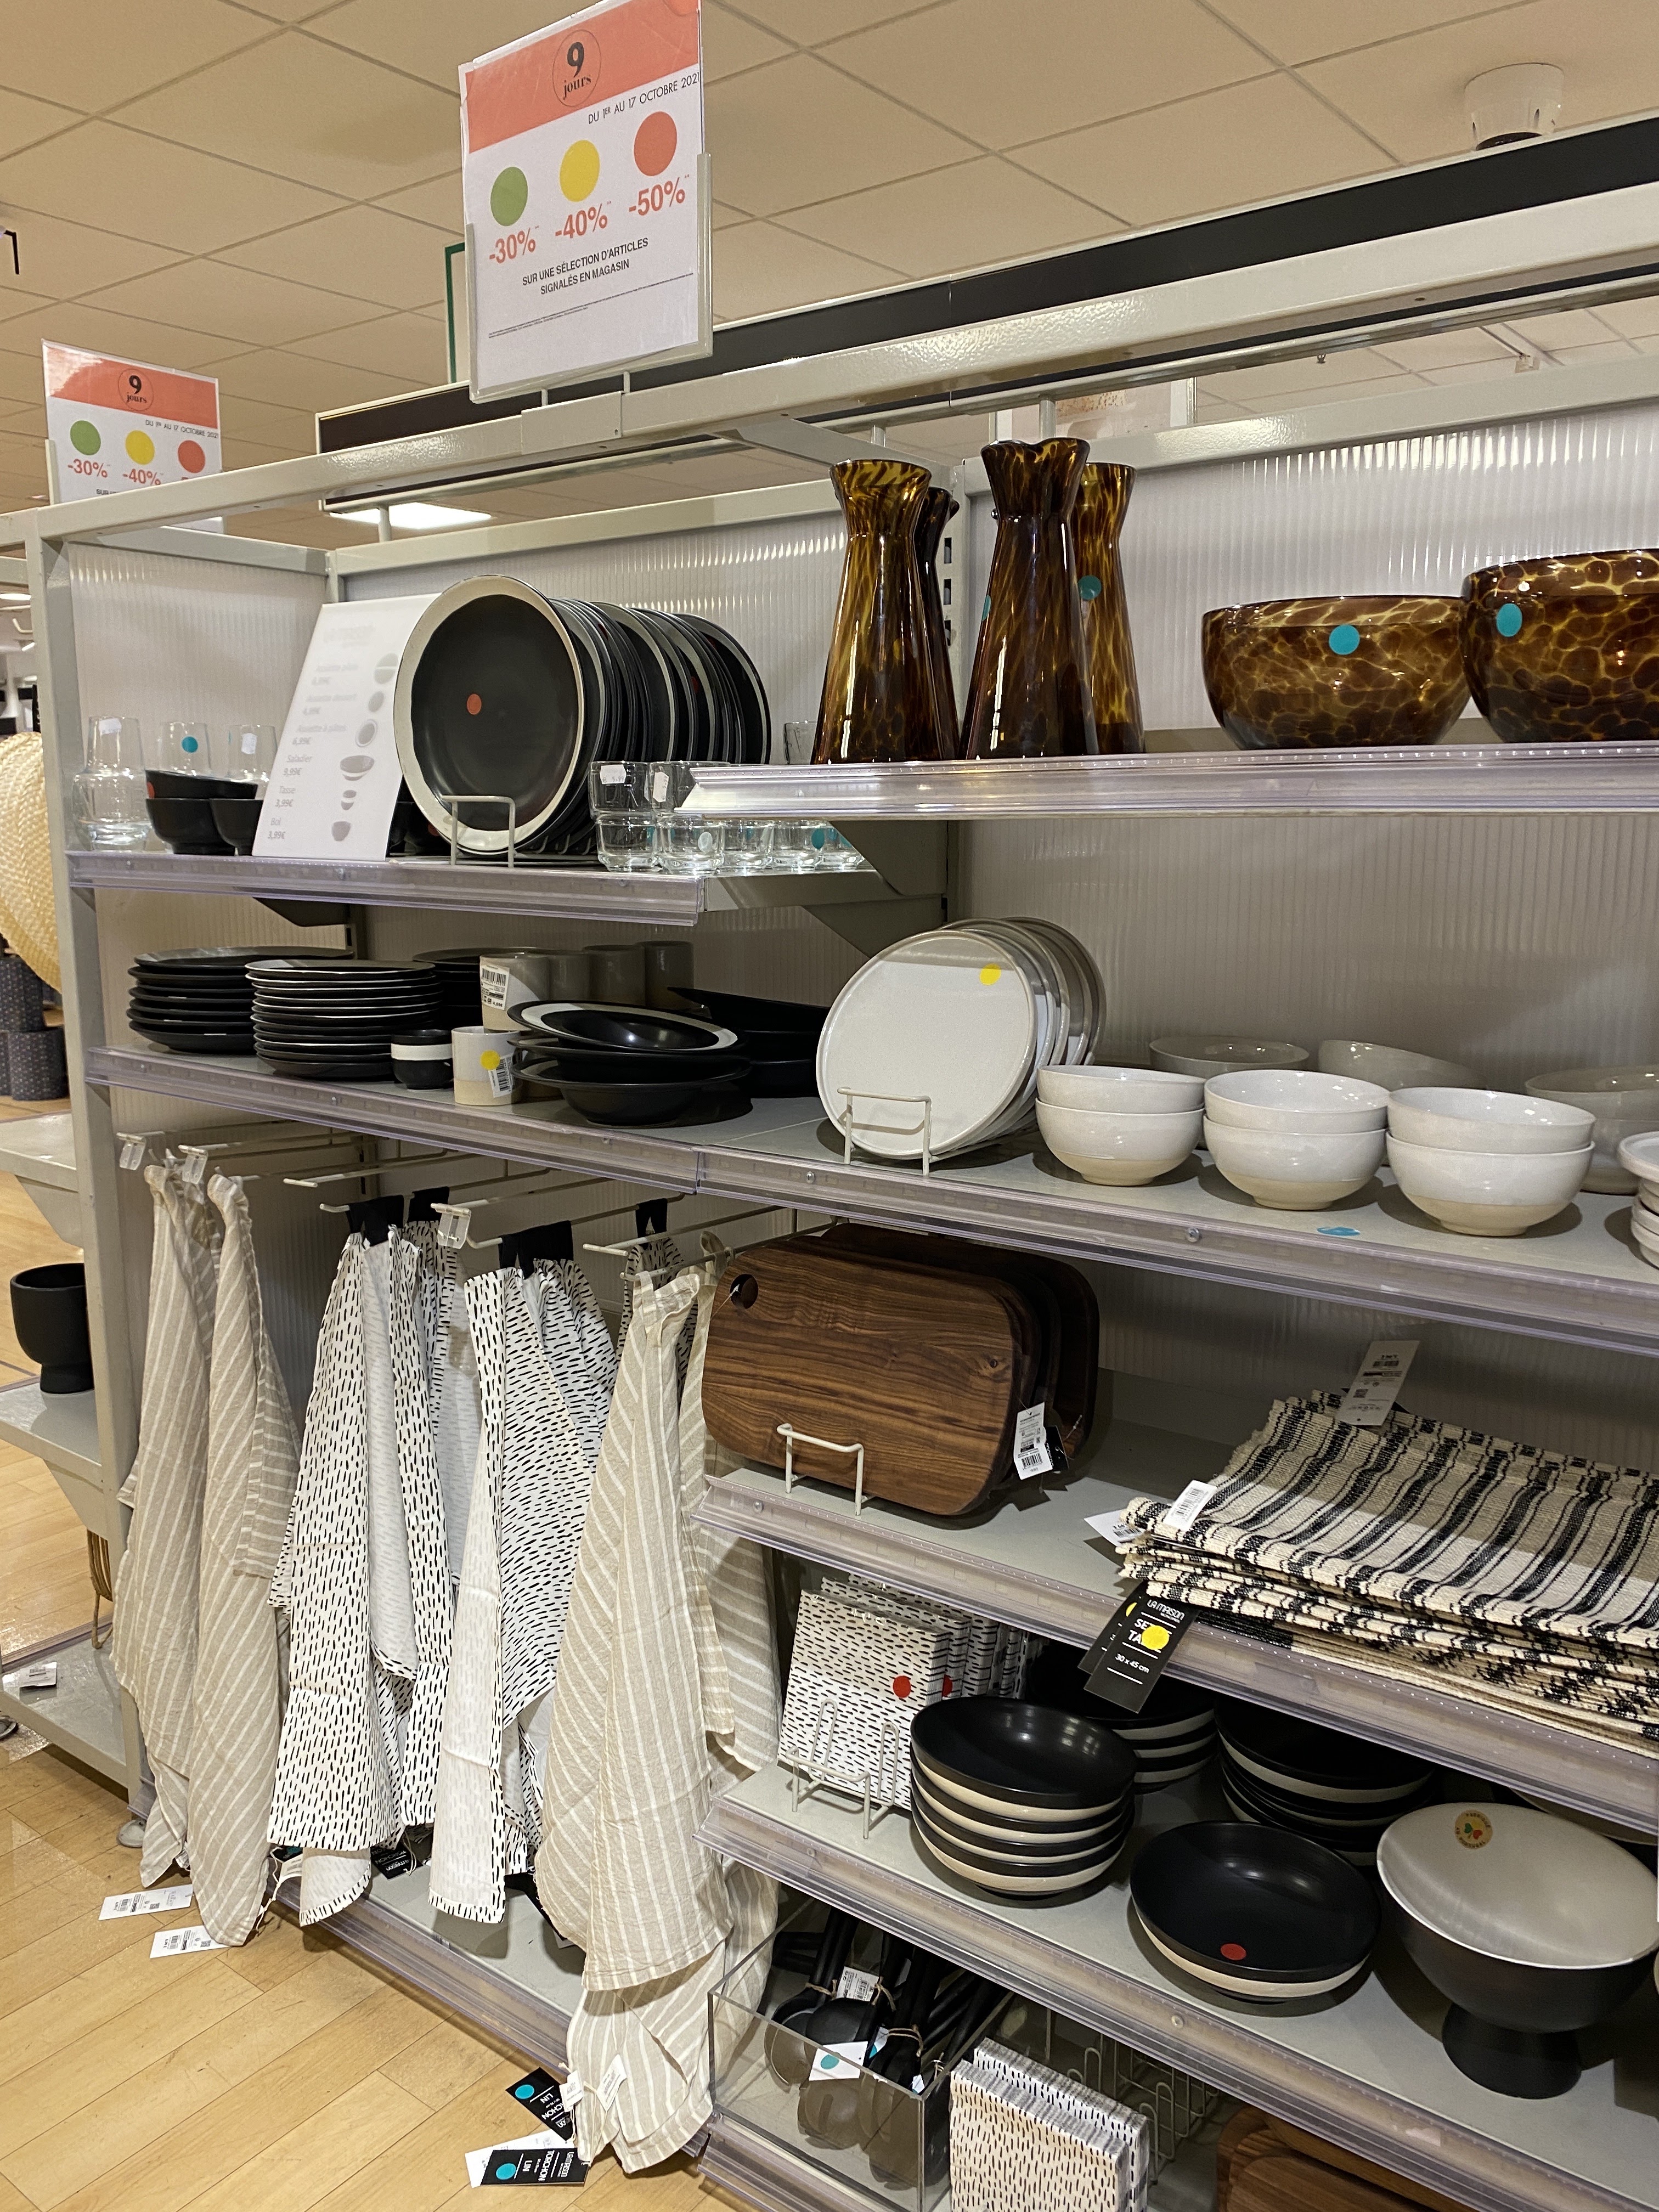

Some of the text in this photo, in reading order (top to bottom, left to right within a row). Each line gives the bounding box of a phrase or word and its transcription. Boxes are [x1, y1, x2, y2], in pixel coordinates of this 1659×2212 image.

[567, 41, 585, 78] 9
[562, 74, 591, 99] jours
[588, 111, 599, 124] DU
[614, 100, 625, 114] AU
[629, 96, 636, 109] 17
[639, 80, 678, 104] OCTOBRE
[681, 71, 699, 88] 2021
[522, 237, 649, 286] SUR UNE SÉLECTION D'ARTICLES
[540, 258, 630, 295] SIGNALÉS EN MAGASIN
[128, 375, 142, 394] 9
[126, 392, 147, 404] jours
[180, 426, 206, 436] OCTOBRE
[283, 768, 302, 777] 9,99€
[279, 786, 295, 794] Tasse
[275, 799, 293, 808] 3,99€
[270, 817, 281, 826] Bol
[268, 831, 285, 840] 3,99€
[1115, 1654, 1125, 1662] 30
[1130, 1660, 1139, 1668] 45
[1138, 1664, 1150, 1673] cm
[540, 2092, 554, 2103] LIN
[541, 2103, 563, 2120] CHON
[522, 2160, 533, 2171] LIN
[538, 2149, 555, 2181] TORCHON
